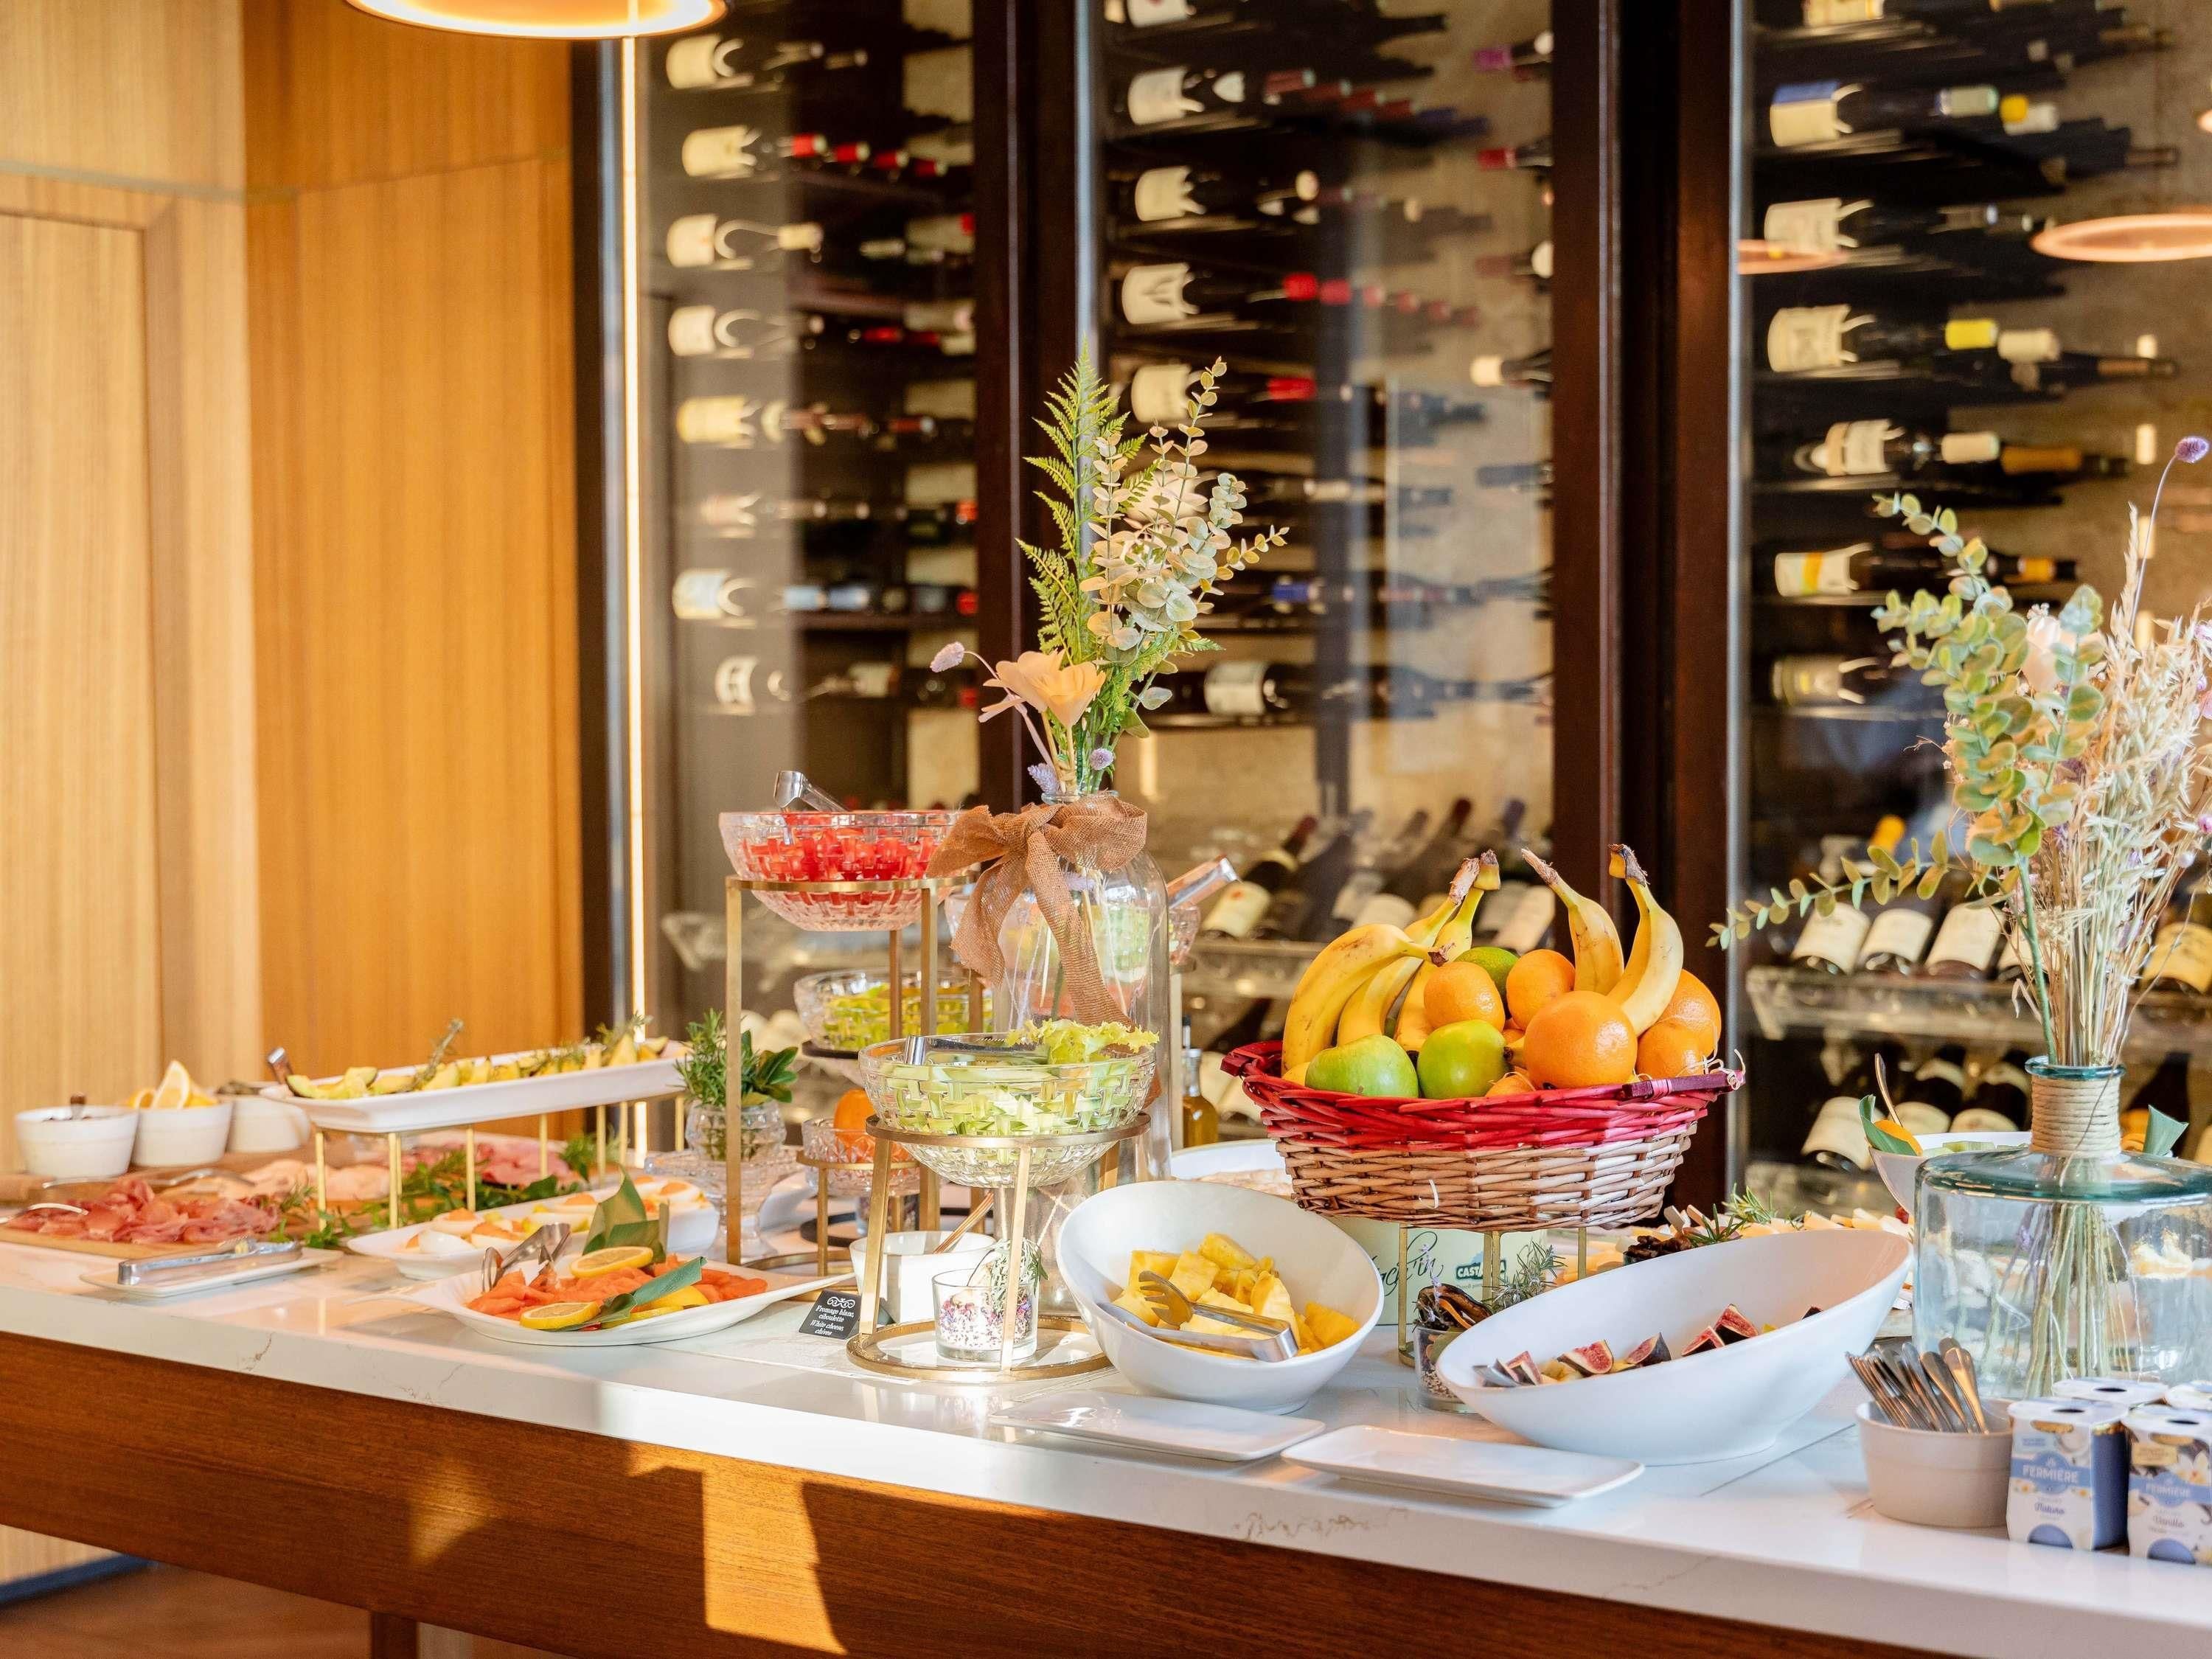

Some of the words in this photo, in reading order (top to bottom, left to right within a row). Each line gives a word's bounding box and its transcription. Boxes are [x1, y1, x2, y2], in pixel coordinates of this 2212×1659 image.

[815, 1305, 839, 1315] Fromage
[818, 1313, 844, 1322] ciboulette
[810, 1320, 826, 1328] White
